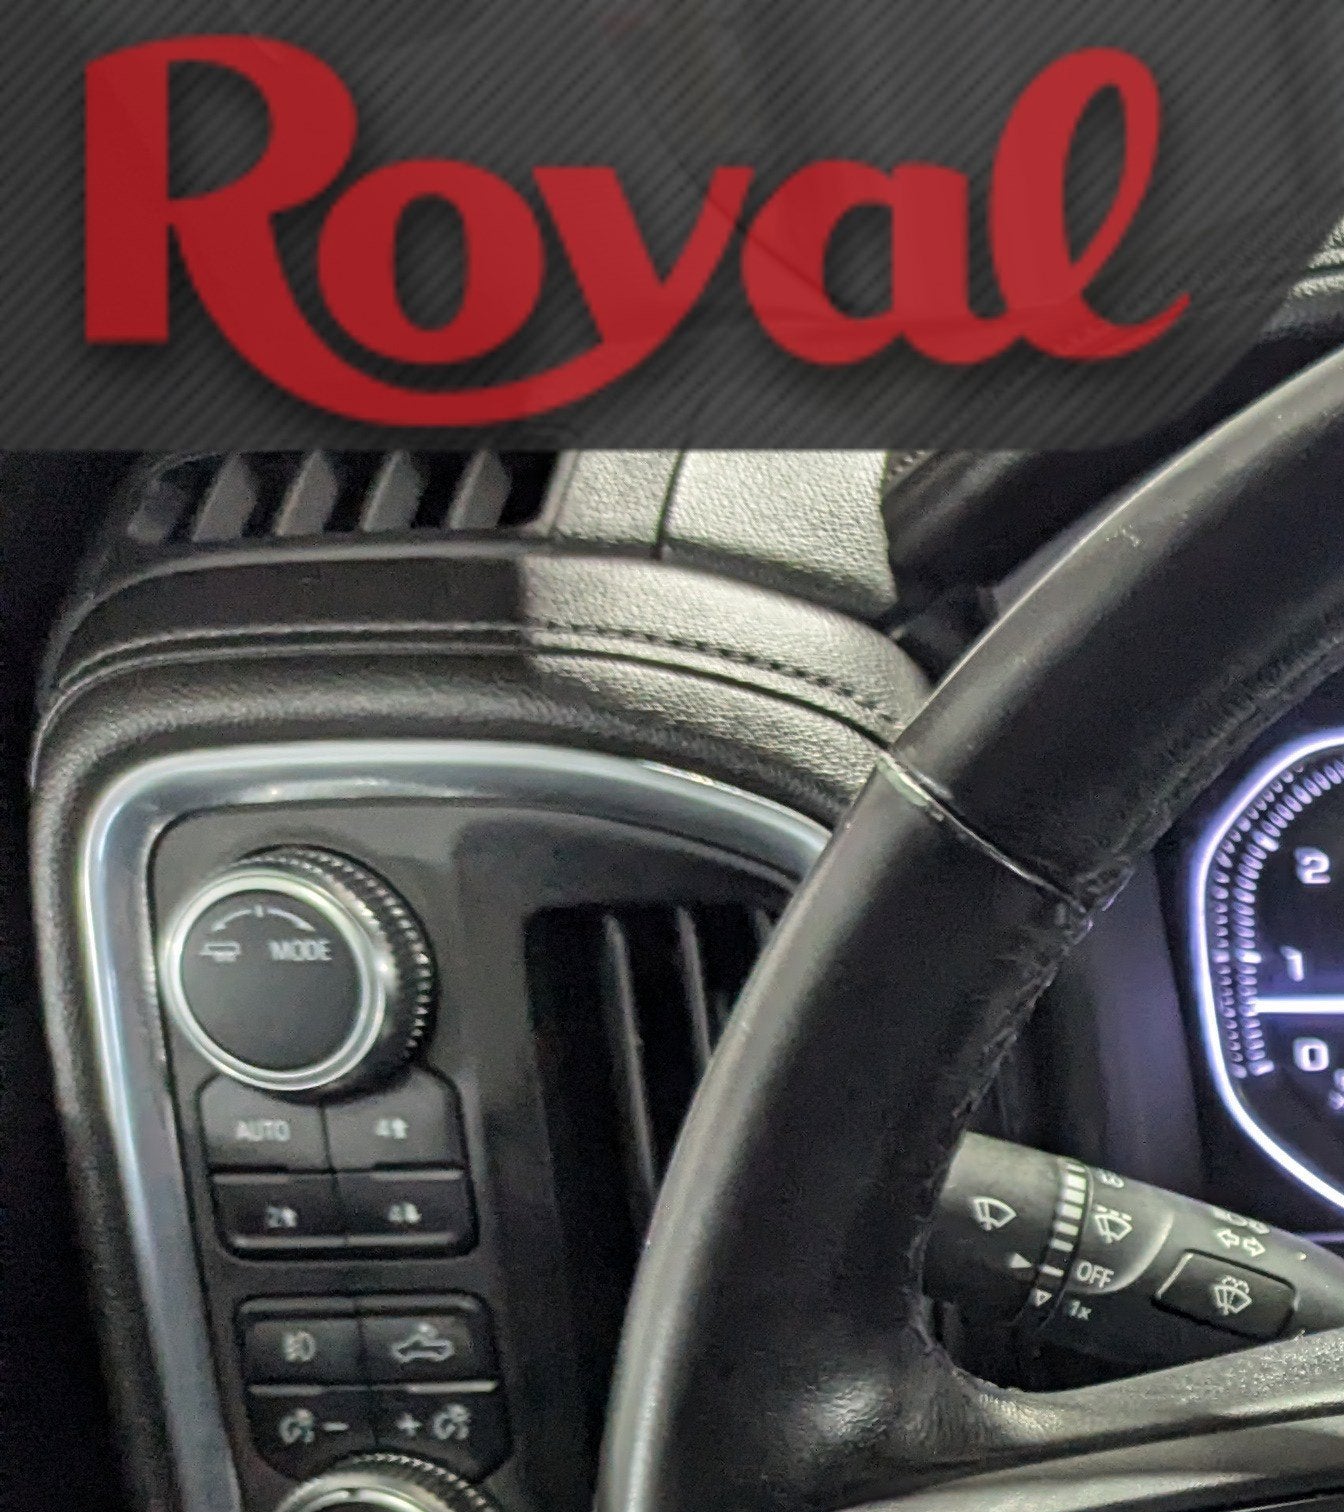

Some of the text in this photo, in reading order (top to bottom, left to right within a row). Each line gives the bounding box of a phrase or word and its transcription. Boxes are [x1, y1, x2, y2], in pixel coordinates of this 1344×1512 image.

[1296, 847, 1330, 884] 2
[268, 939, 333, 962] MODE
[1282, 946, 1303, 980] 1
[1294, 1038, 1328, 1072] 0
[235, 1120, 290, 1142] AUTO
[1076, 1261, 1114, 1288] OFF
